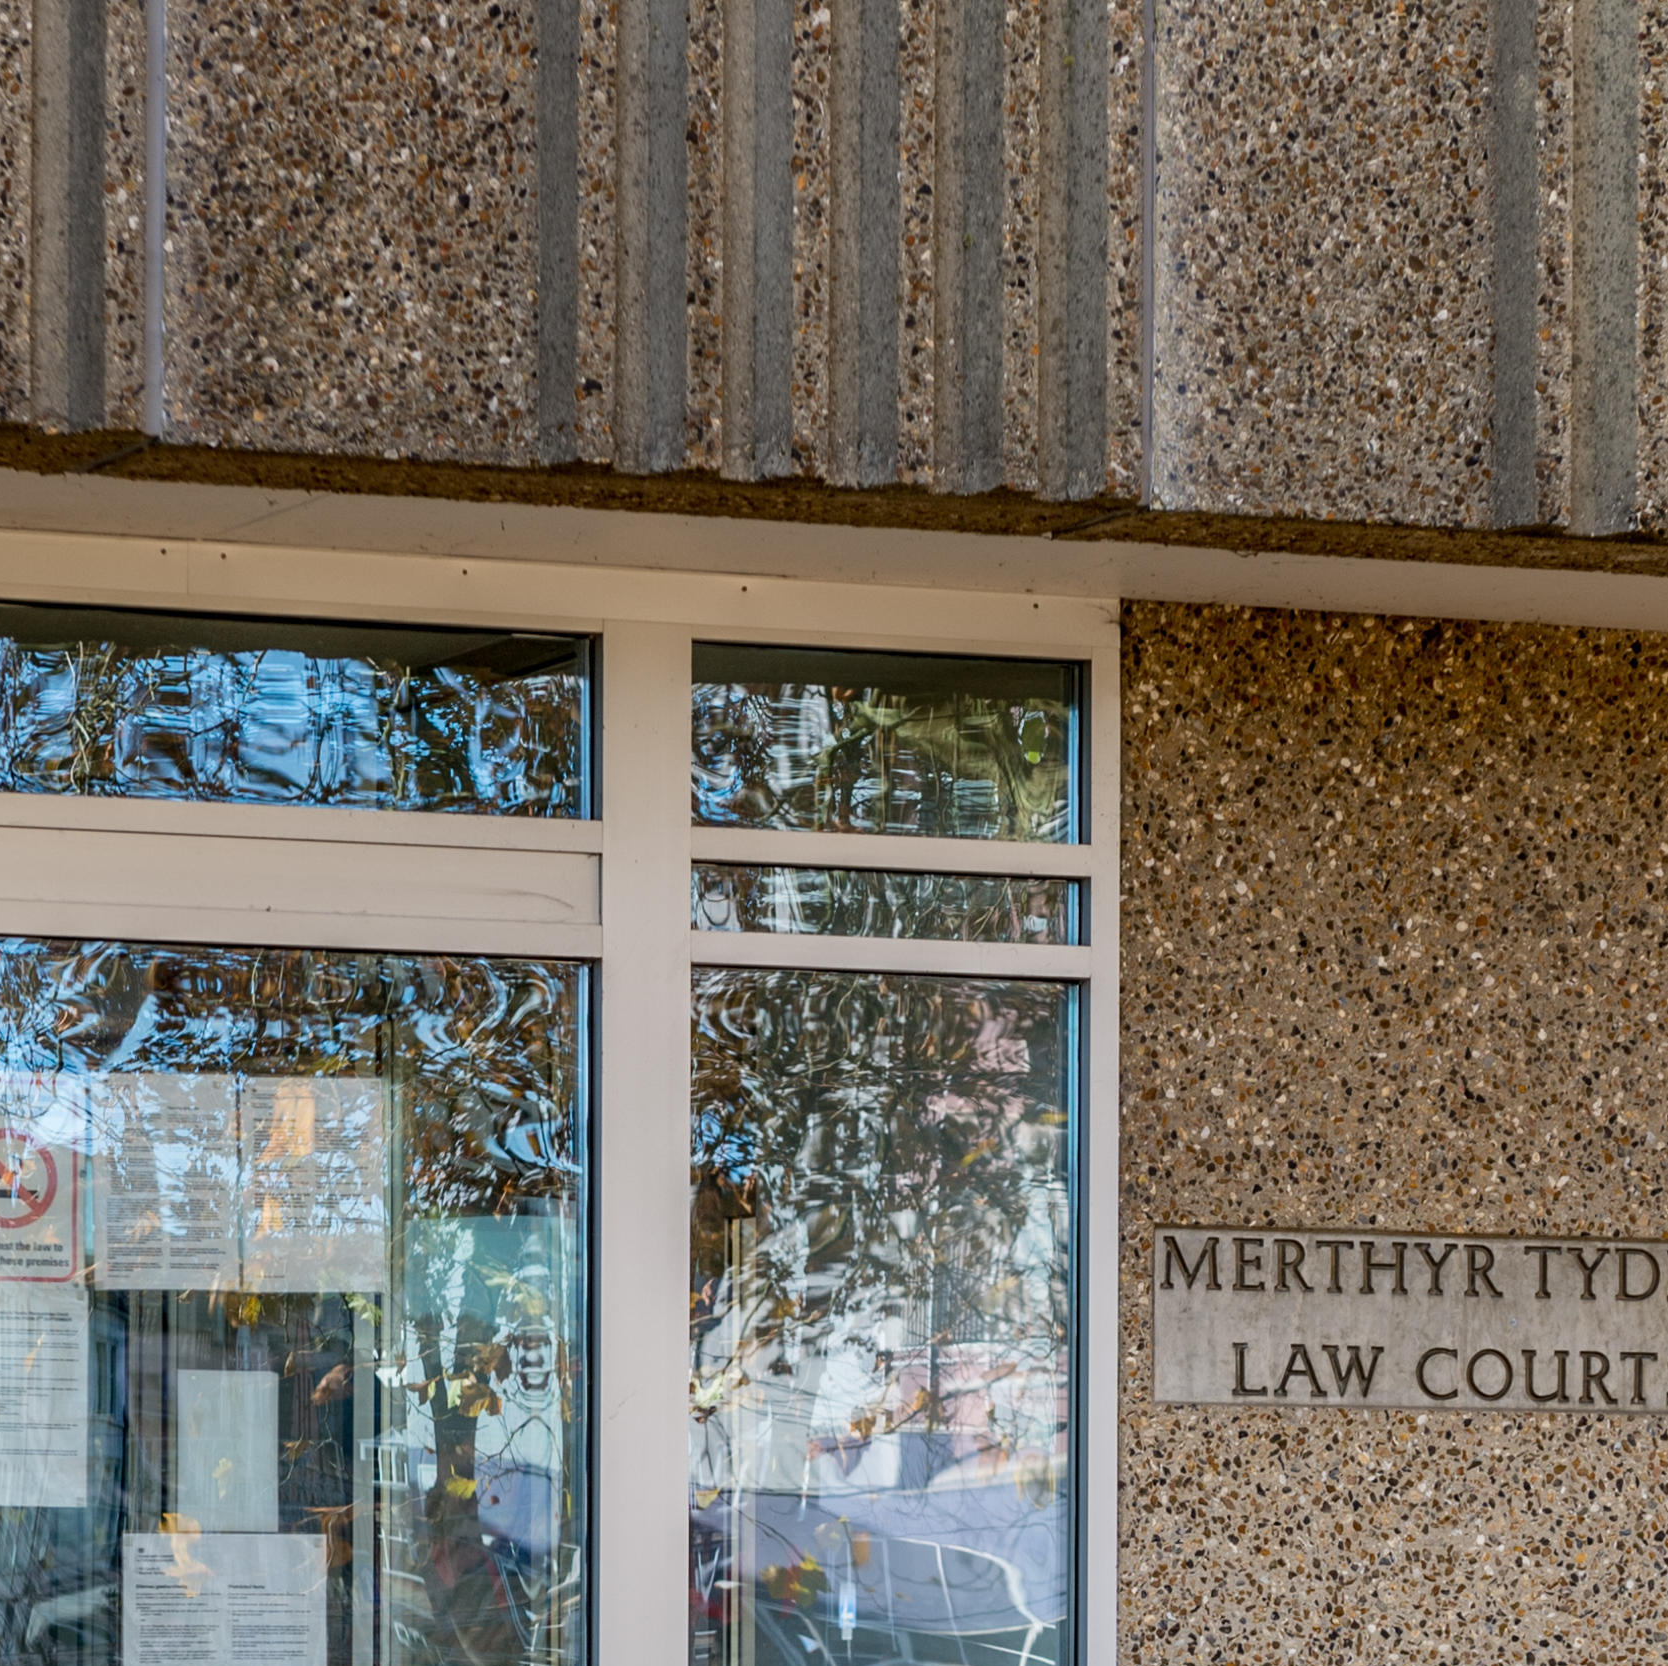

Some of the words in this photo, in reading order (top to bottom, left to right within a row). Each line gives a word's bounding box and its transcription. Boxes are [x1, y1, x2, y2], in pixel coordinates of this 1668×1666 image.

[15, 1242, 30, 1251] the
[33, 1242, 52, 1252] law
[54, 1243, 63, 1252] to
[25, 1256, 70, 1269] premises
[1159, 1236, 1503, 1298] MERTHYR
[1231, 1342, 1385, 1399] LAW
